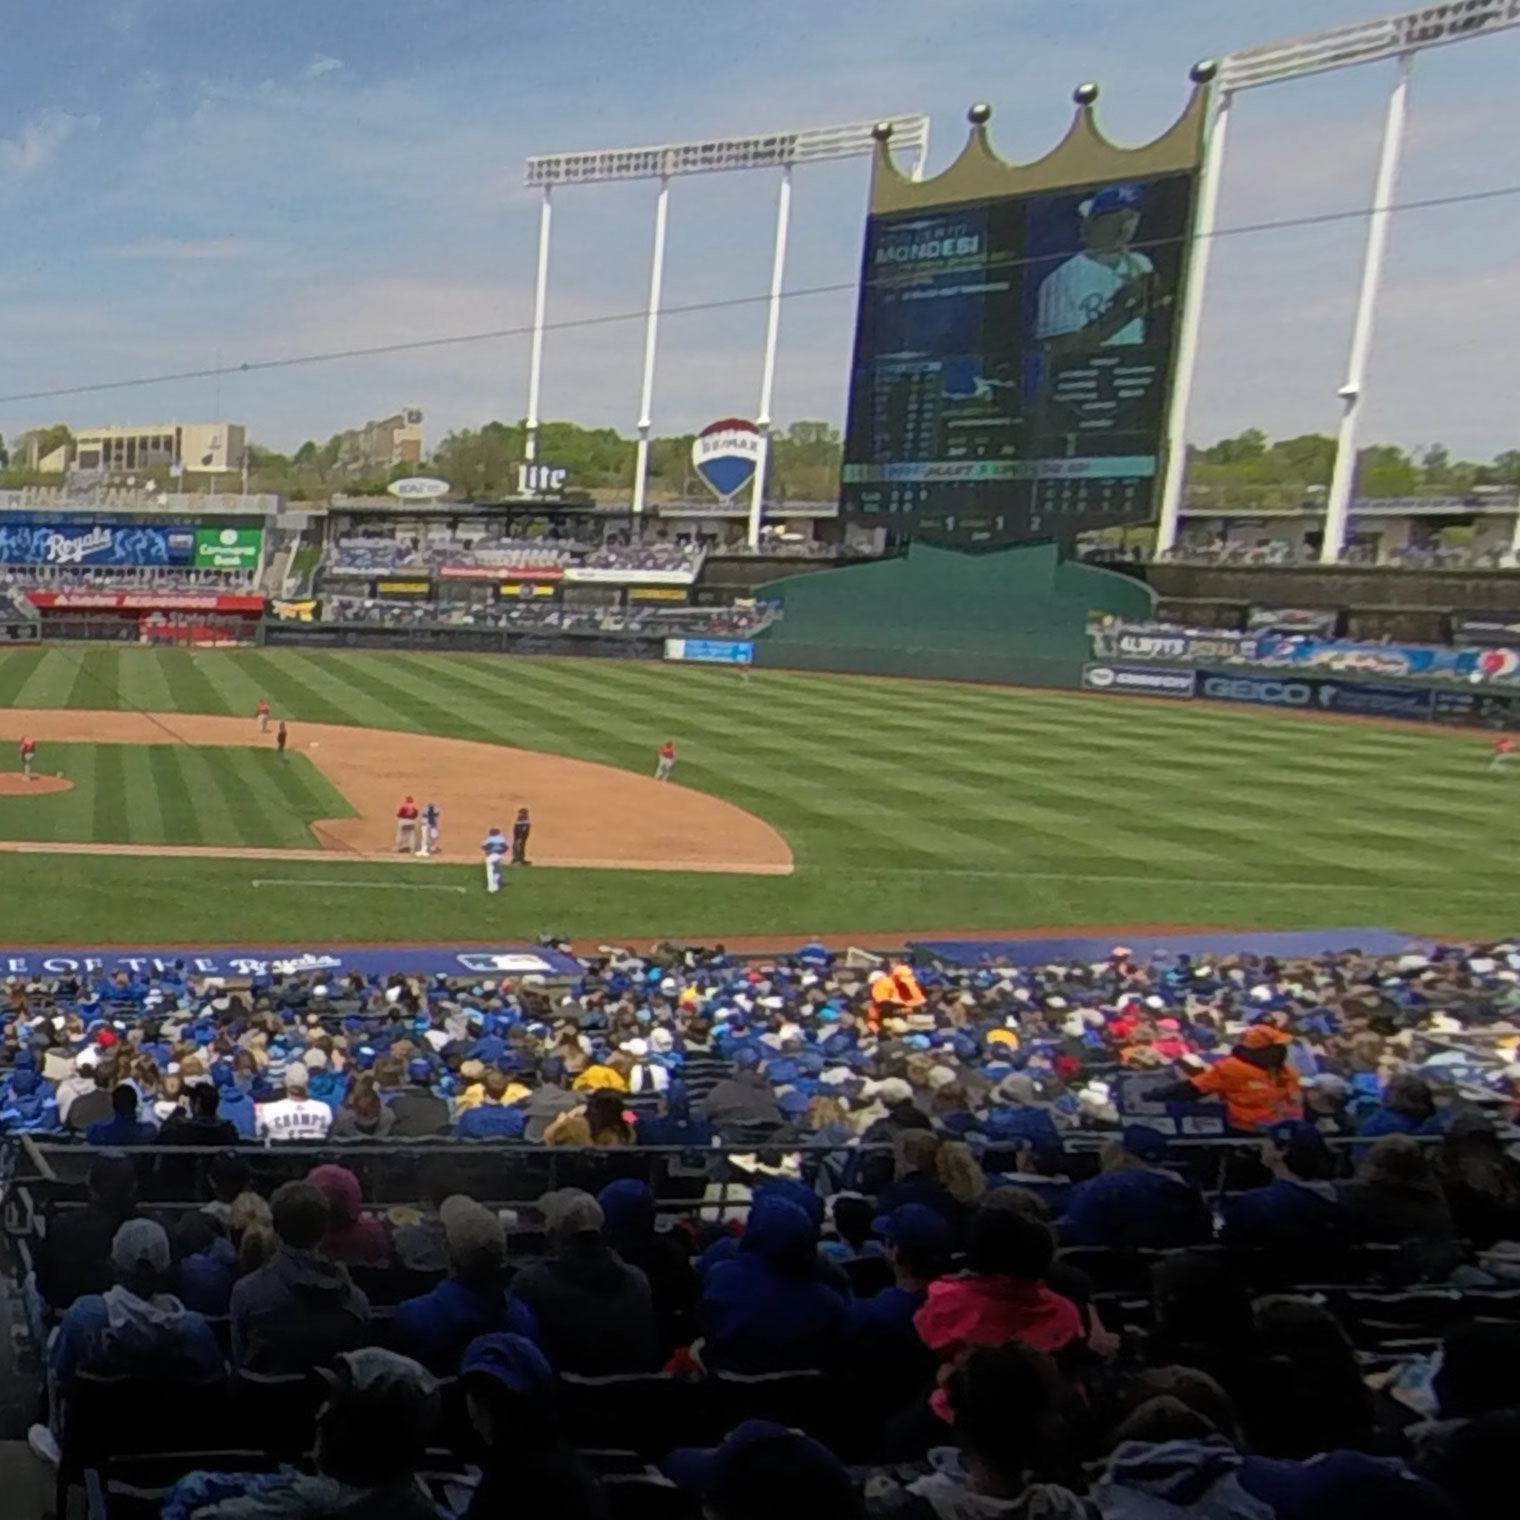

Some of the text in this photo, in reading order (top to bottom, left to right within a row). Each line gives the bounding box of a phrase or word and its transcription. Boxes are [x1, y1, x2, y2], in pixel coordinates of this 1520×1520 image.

[874, 234, 979, 265] MONDESI
[702, 438, 758, 454] RE/MAX
[517, 464, 567, 497] Lite
[46, 526, 112, 562] Royals
[1204, 676, 1311, 705] GEICO
[43, 957, 103, 972] OF
[117, 957, 219, 972] THE
[273, 1113, 327, 1130] CHAMPS
